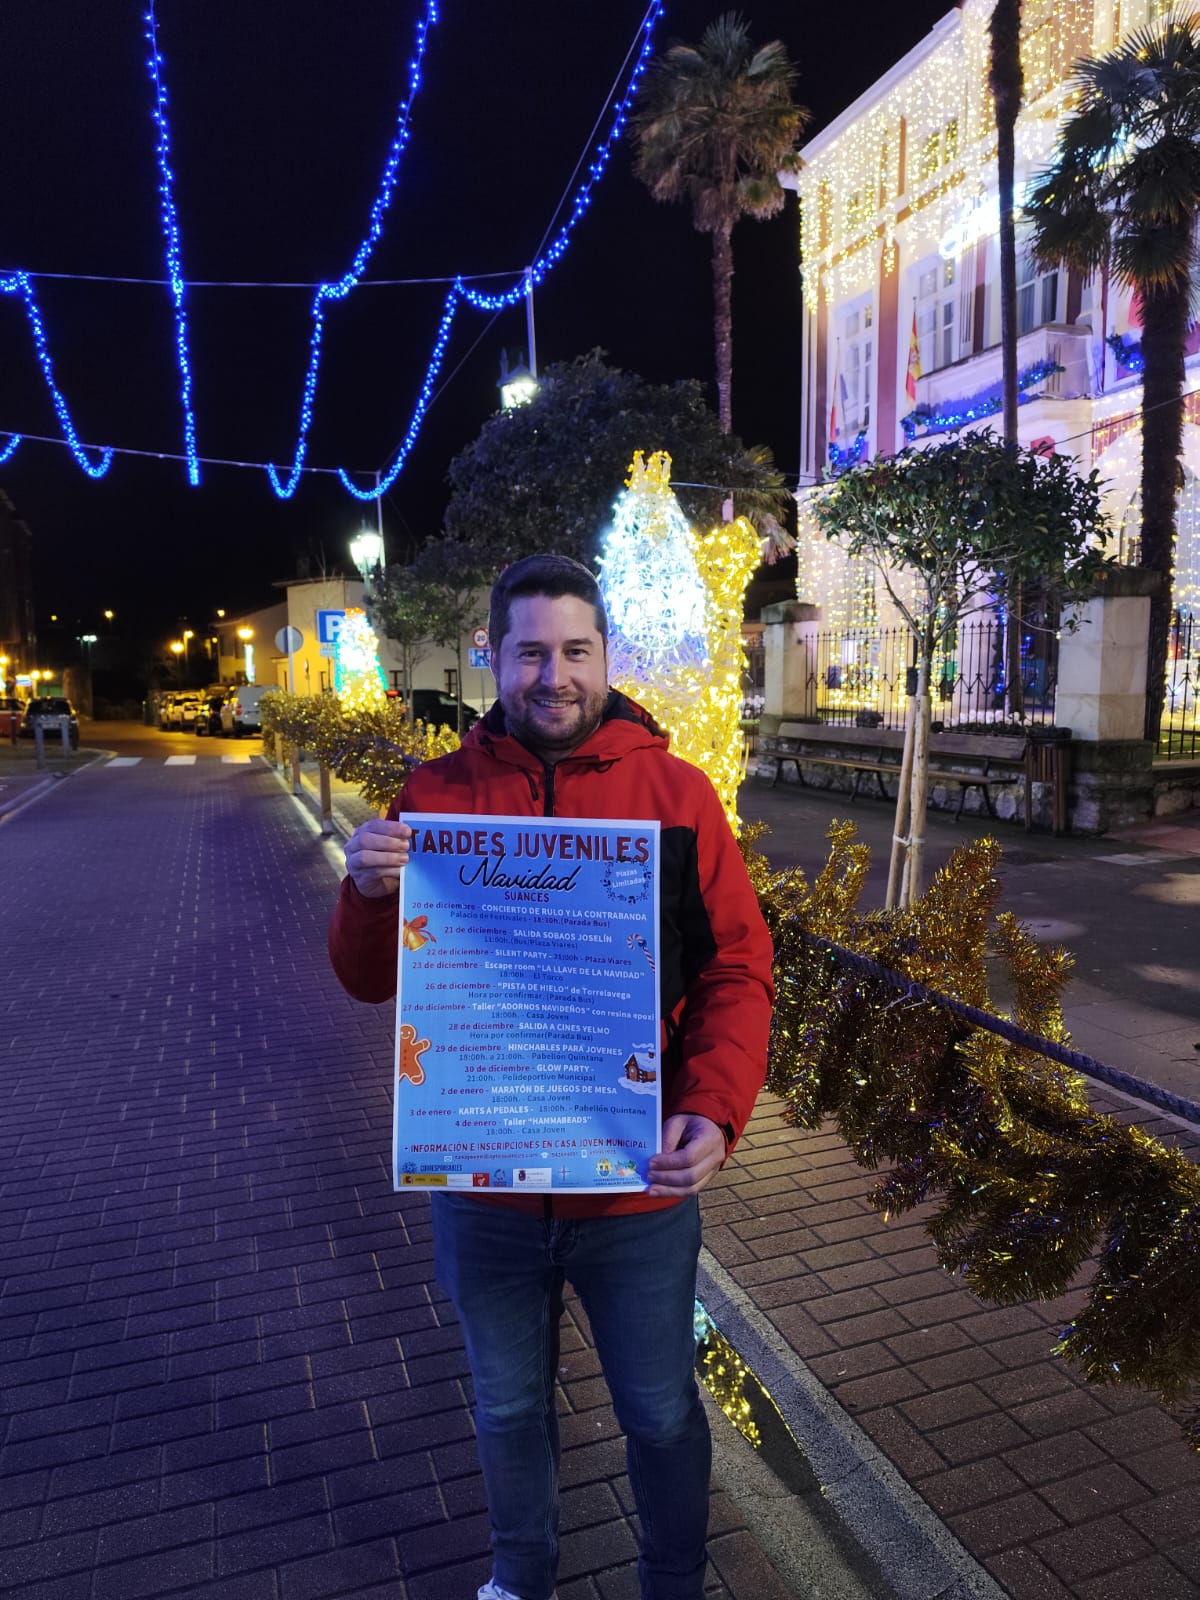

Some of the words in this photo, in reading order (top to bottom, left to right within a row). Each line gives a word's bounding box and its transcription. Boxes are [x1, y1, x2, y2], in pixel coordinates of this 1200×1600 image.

[326, 615, 345, 640] P
[410, 829, 505, 858] TARDES
[514, 832, 649, 862] JUVENILES
[459, 853, 582, 892] Navidad
[616, 870, 638, 878] Plazas
[612, 878, 646, 888] Limitadas
[504, 891, 550, 903] SUANCES
[436, 902, 475, 910] diciembre
[482, 904, 527, 914] CONCIERTO
[542, 908, 564, 916] RULO
[584, 911, 647, 920] CONTRABANDA
[451, 911, 478, 919] Palacio
[468, 927, 507, 935] diciembre
[543, 932, 575, 940] SOBAOS
[578, 934, 612, 942] JOSELÍN
[523, 951, 547, 959] PARTY
[485, 962, 512, 970] Escape
[489, 992, 502, 1000] por
[582, 988, 631, 999] Torrelavega
[426, 1003, 465, 1011] diciembre
[608, 1010, 631, 1018] resina
[557, 1024, 580, 1032] CINES
[582, 1026, 610, 1034] YELMO
[460, 1044, 501, 1052] diciembre
[508, 1043, 560, 1051] HINCHABLES
[562, 1044, 584, 1052] PARA
[586, 1047, 623, 1055] JOVENES
[568, 1054, 603, 1062] Quintana
[489, 1064, 530, 1072] diciembre
[537, 1064, 561, 1072] GLOW
[563, 1064, 590, 1072] PARTY
[492, 1084, 531, 1093] MARATÓN
[595, 1086, 617, 1094] MESA
[459, 1107, 485, 1115] KARTS
[494, 1106, 528, 1114] PEDALES
[611, 1106, 647, 1115] Quintana
[411, 1141, 467, 1152] INFORMACIÓN
[477, 1140, 540, 1151] INSCRIPCIONES
[542, 1140, 552, 1148] EN
[555, 1140, 576, 1148] CASA
[579, 1139, 604, 1147] JOVEN
[606, 1139, 648, 1148] MUNICIPAL
